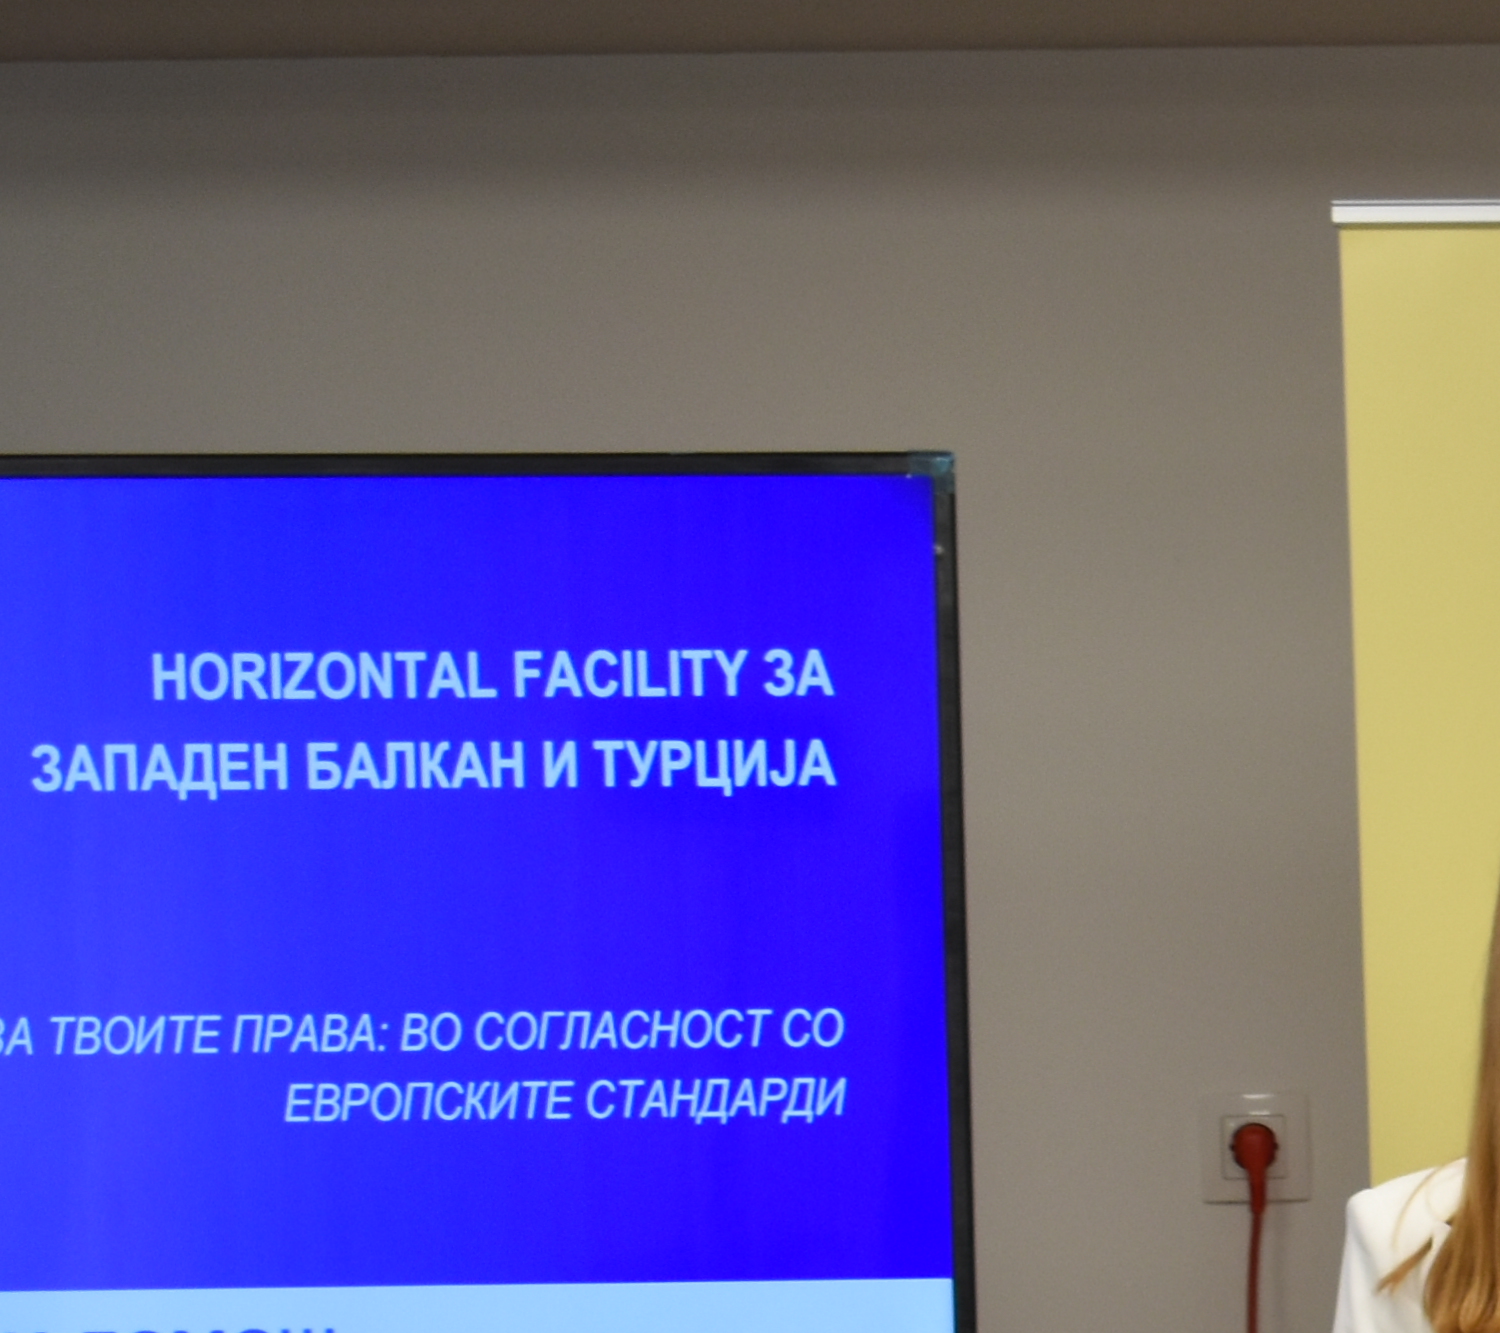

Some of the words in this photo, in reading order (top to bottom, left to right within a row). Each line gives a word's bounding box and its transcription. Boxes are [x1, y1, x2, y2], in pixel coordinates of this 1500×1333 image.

[152, 650, 498, 701] HORIZONTAL
[513, 648, 749, 698] FACILITY
[763, 648, 835, 697] ЗА
[31, 742, 288, 801] ЗАПАДЕН
[306, 740, 525, 790] БАЛКАН
[542, 740, 578, 788] И
[592, 738, 837, 797] ТУРЦИЈА
[0, 1016, 33, 1056] А
[49, 1014, 222, 1056] ТВОИТЕ
[231, 1013, 389, 1053] ПРАВА:
[400, 1011, 463, 1052] ВО
[474, 1008, 773, 1052] СОГЛАСНОСТ
[782, 1007, 845, 1048] СО
[284, 1080, 575, 1123] ЕВРОПСКИТЕ
[586, 1076, 847, 1125] СТАНДАРДИ
